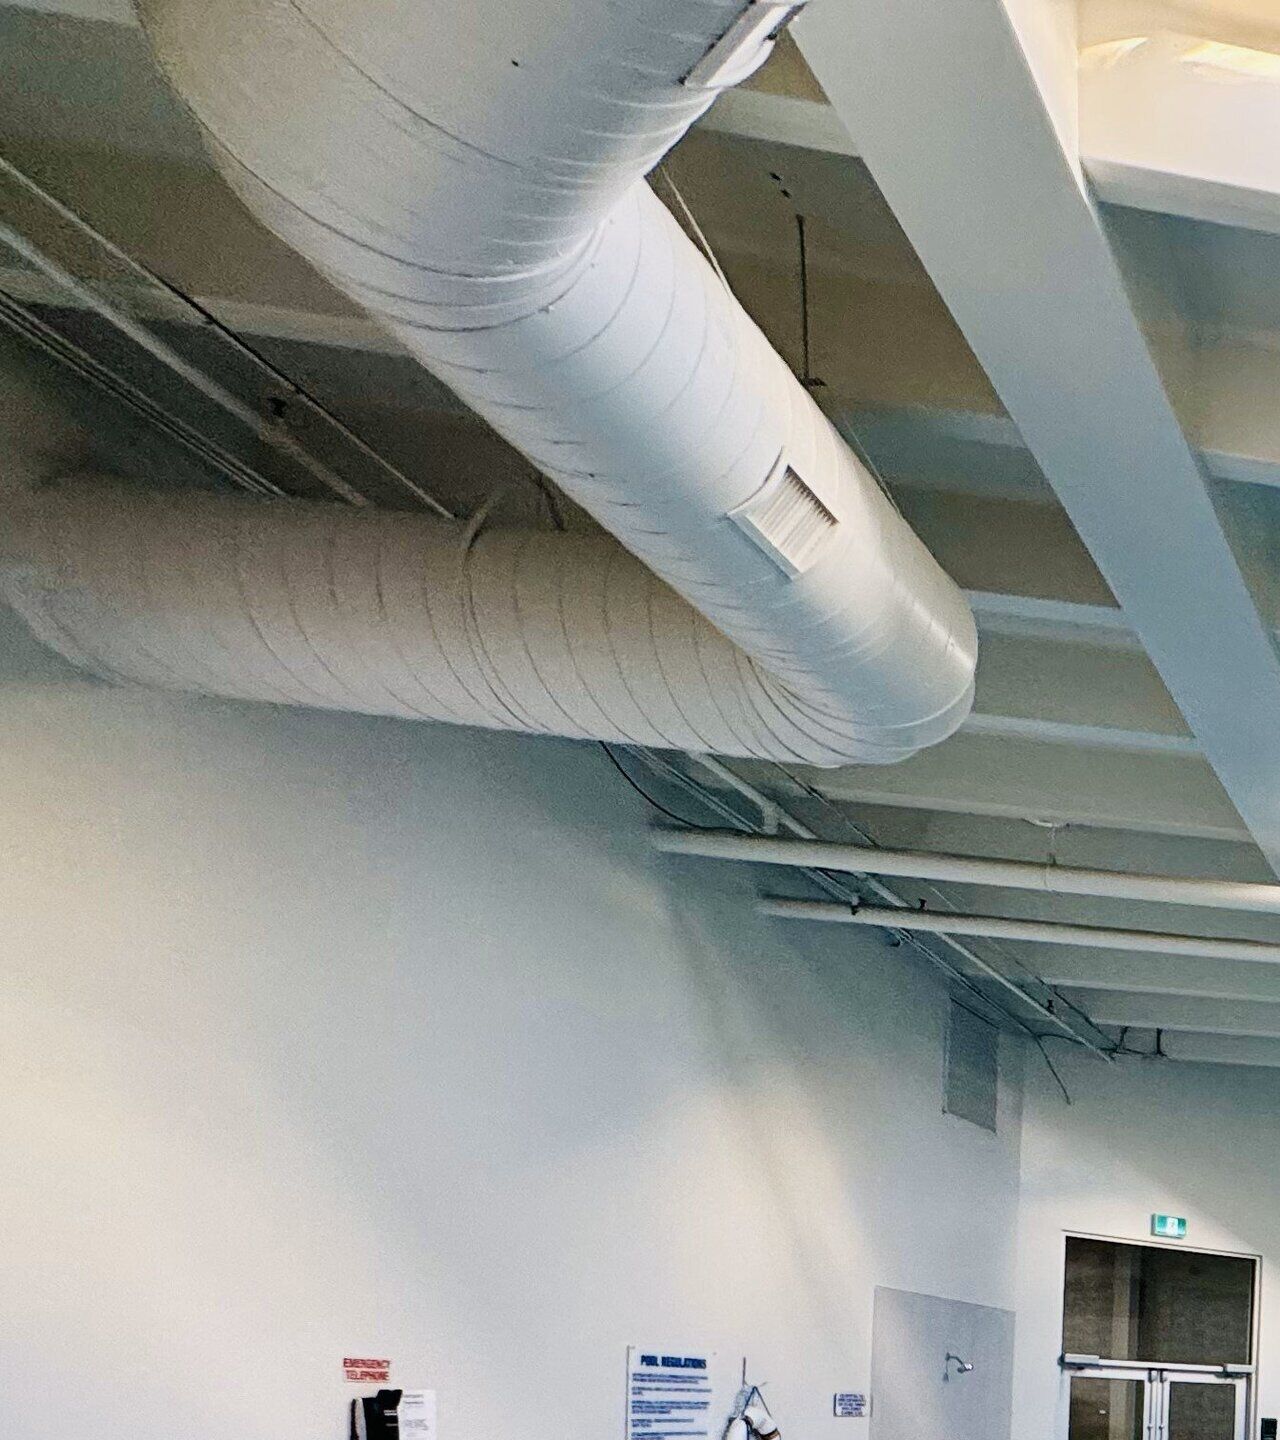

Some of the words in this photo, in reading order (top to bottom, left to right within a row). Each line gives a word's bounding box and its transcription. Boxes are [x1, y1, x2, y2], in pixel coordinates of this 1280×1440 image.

[343, 1358, 390, 1369] EMERGENCY
[641, 1355, 659, 1367] POOL
[661, 1356, 706, 1369] REGULATIONS
[346, 1370, 389, 1381] TELEPHONE
